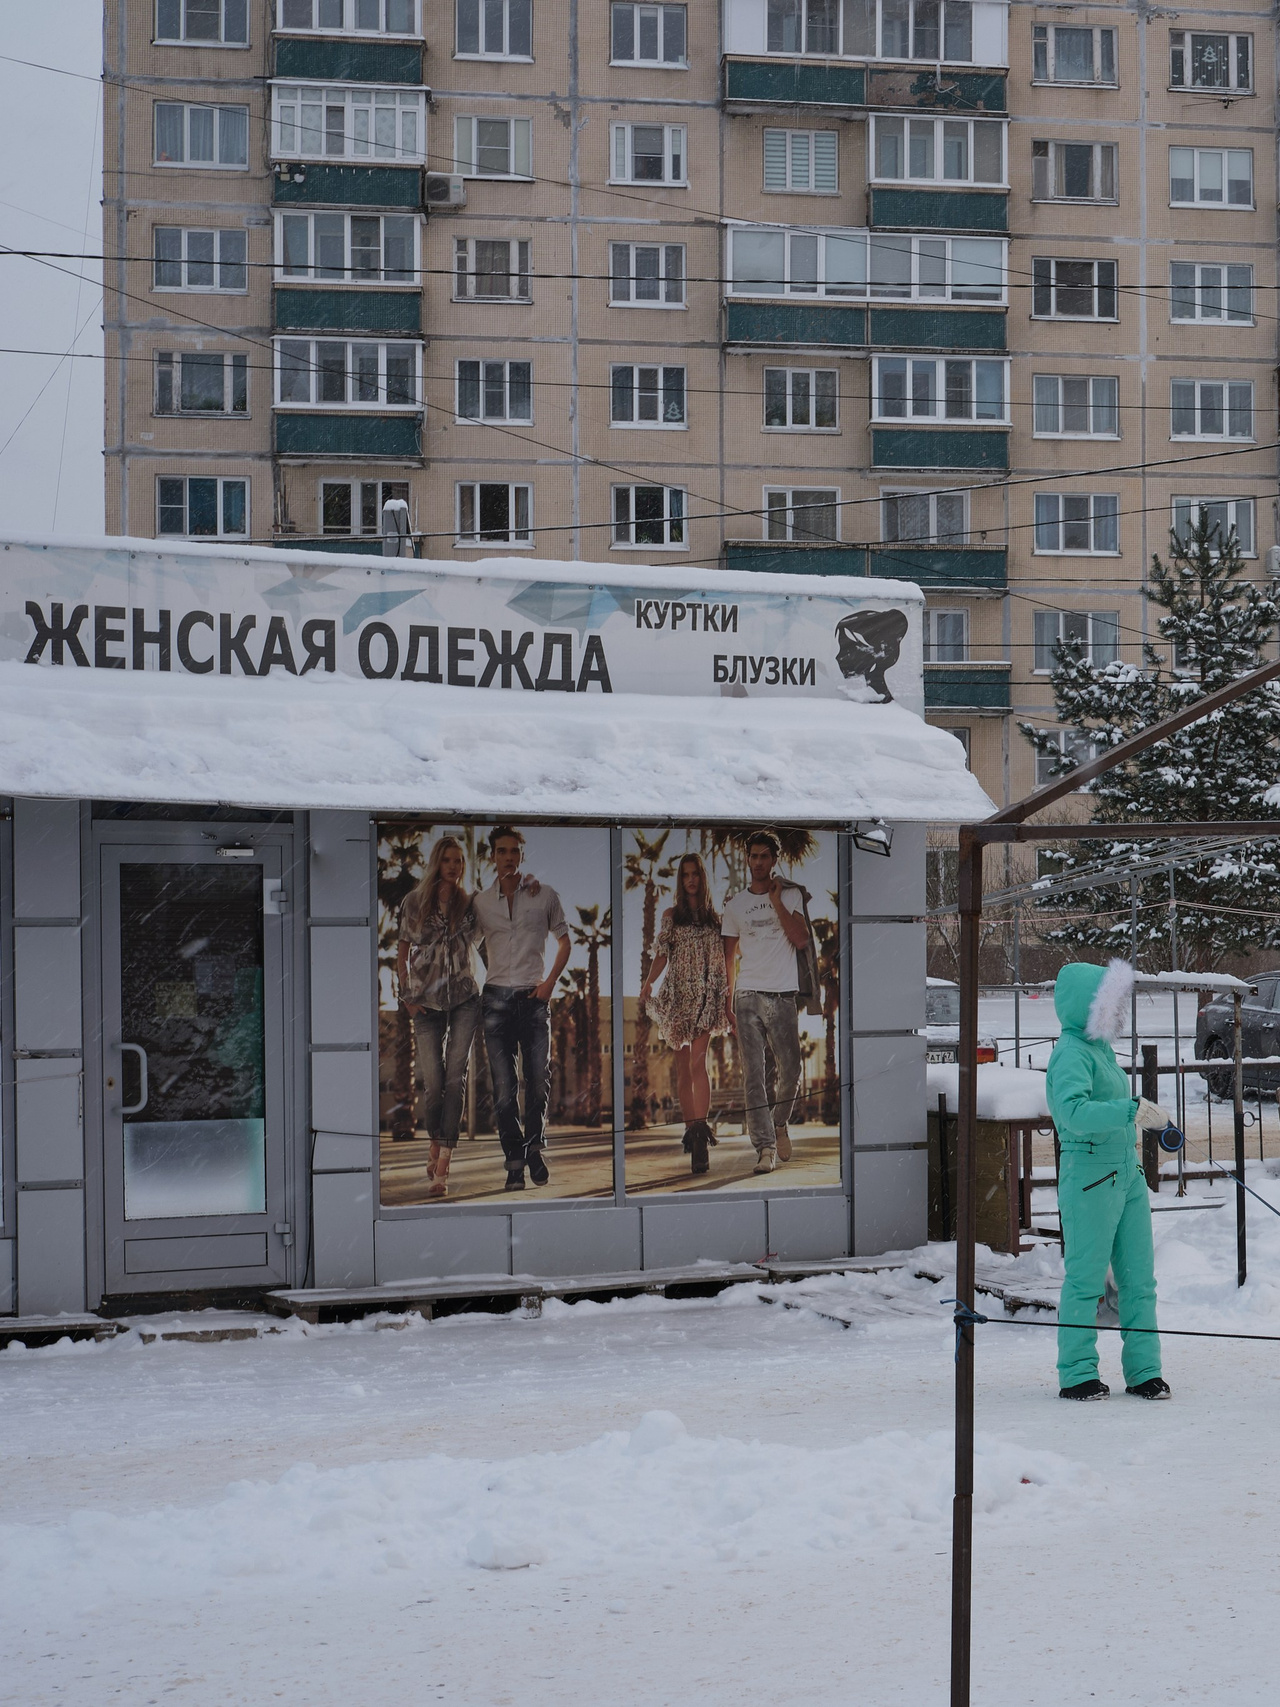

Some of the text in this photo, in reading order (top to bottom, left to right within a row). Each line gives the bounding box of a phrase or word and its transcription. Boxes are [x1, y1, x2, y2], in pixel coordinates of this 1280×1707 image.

[635, 599, 739, 633] КУРТКИ
[24, 599, 613, 694] ЖЕНСКАЯ ОДЕЖДА
[713, 654, 816, 687] БЛУЗКИ
